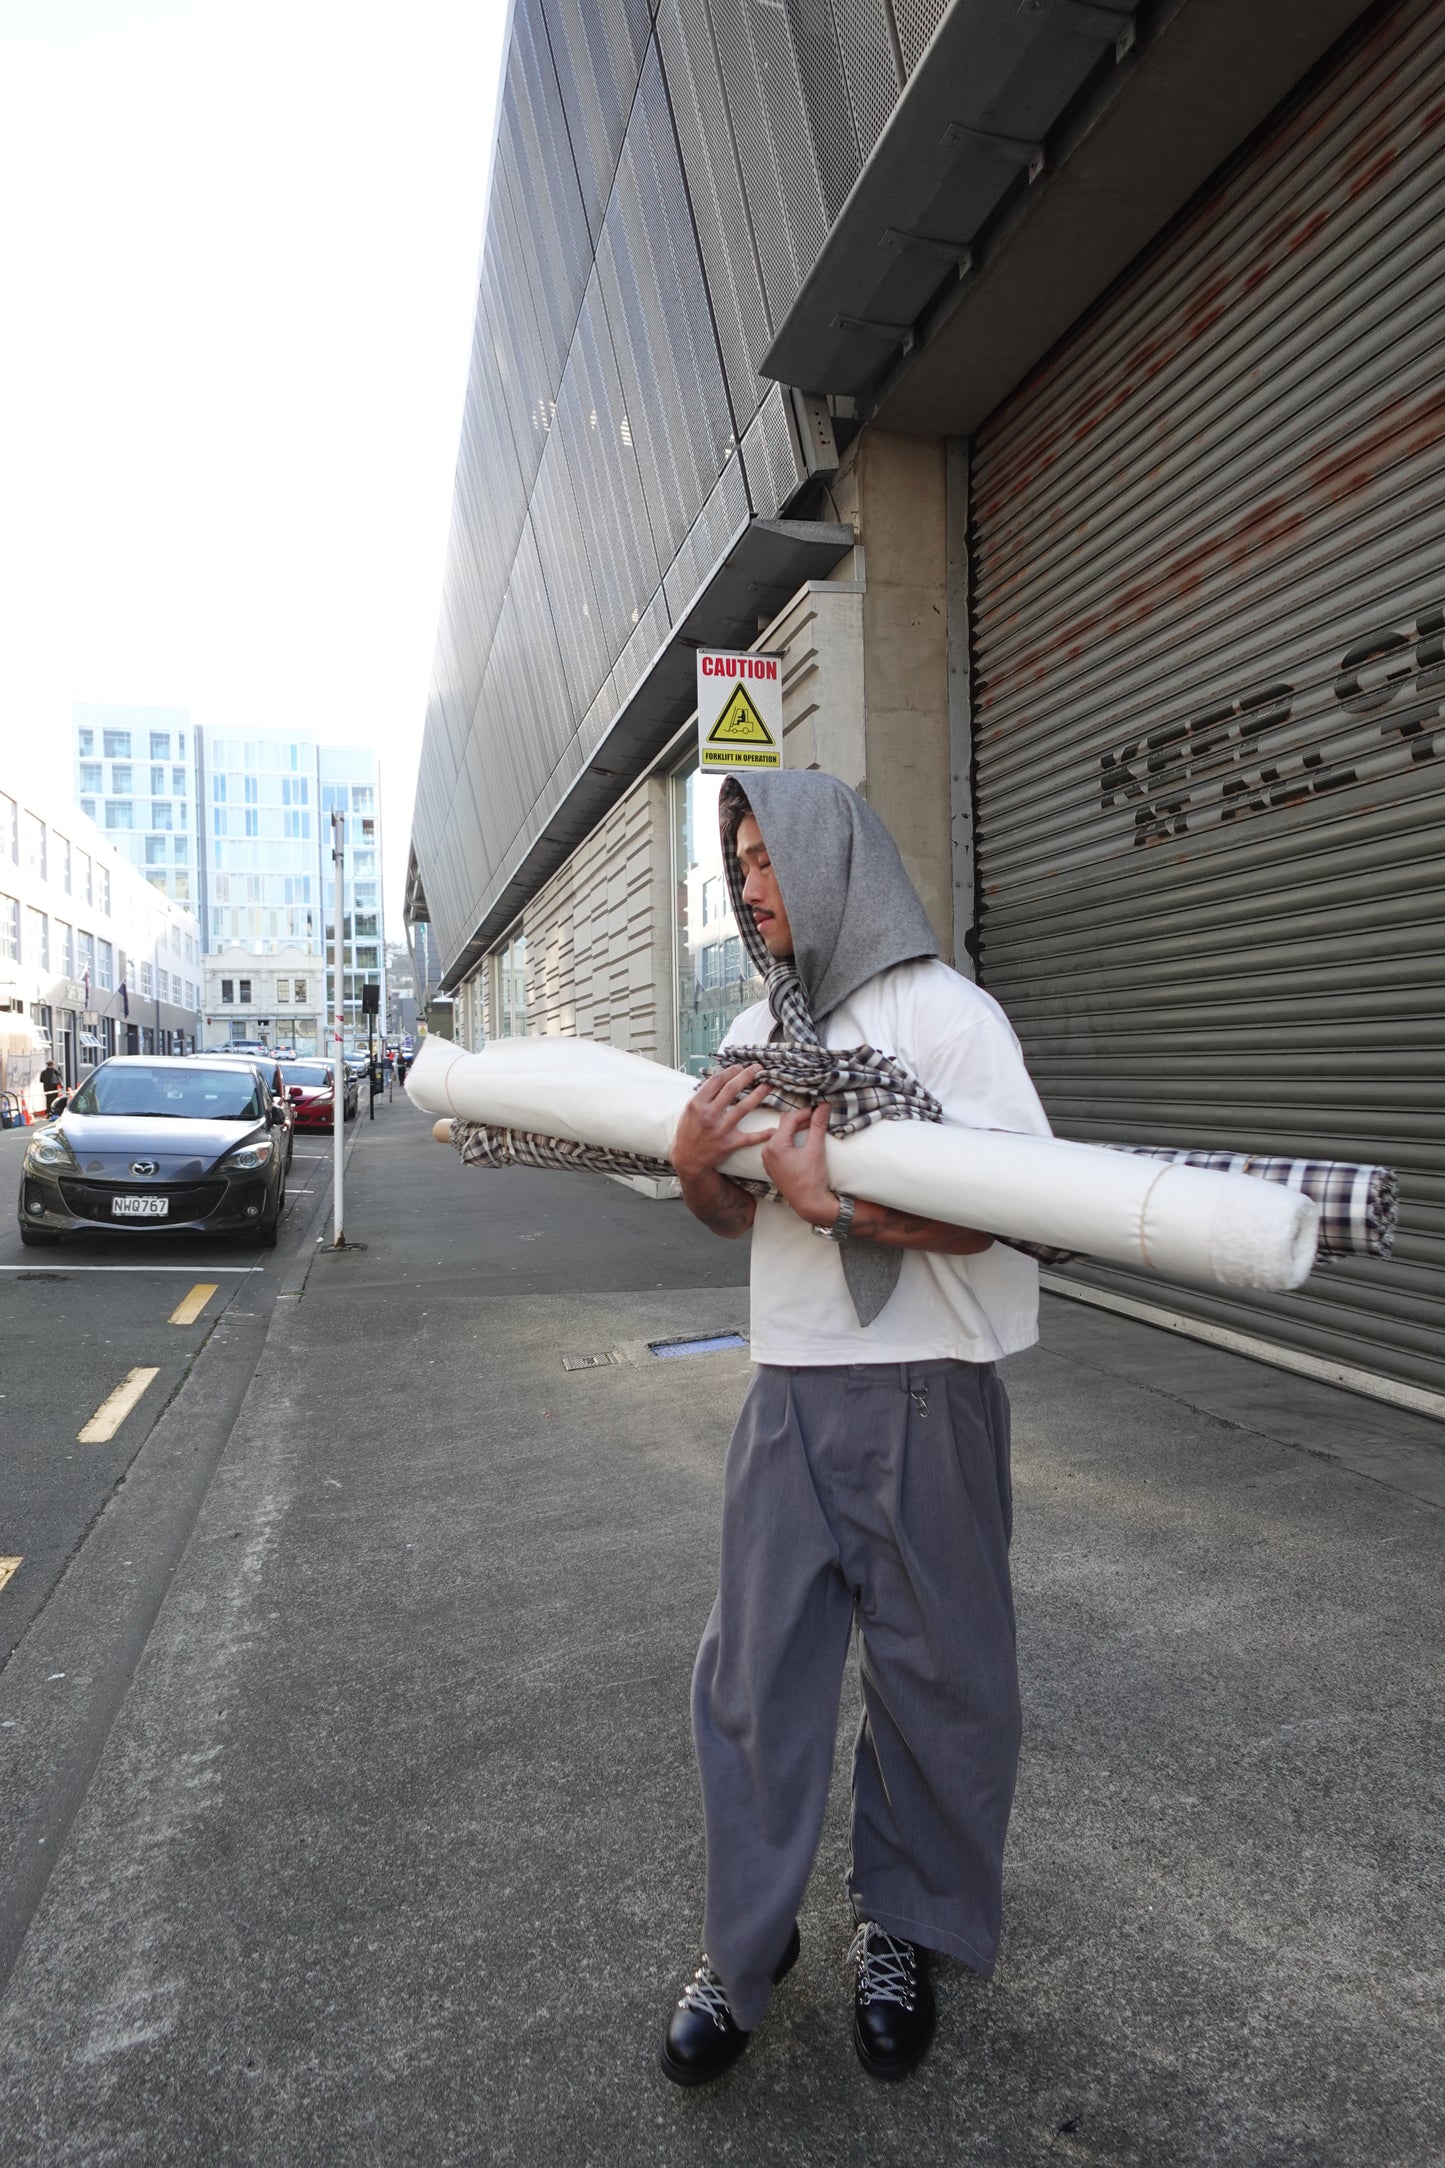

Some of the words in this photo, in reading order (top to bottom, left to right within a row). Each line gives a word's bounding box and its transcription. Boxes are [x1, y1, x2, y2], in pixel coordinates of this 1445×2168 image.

[702, 656, 777, 680] CAUTION
[705, 752, 734, 761] FORKLIFT
[735, 753, 742, 762] IN
[743, 754, 777, 763] OPERATION
[1100, 682, 1296, 809] KEEP
[1134, 792, 1191, 847] AT
[1220, 749, 1357, 821] ALL
[114, 1199, 167, 1213] NWQ767
